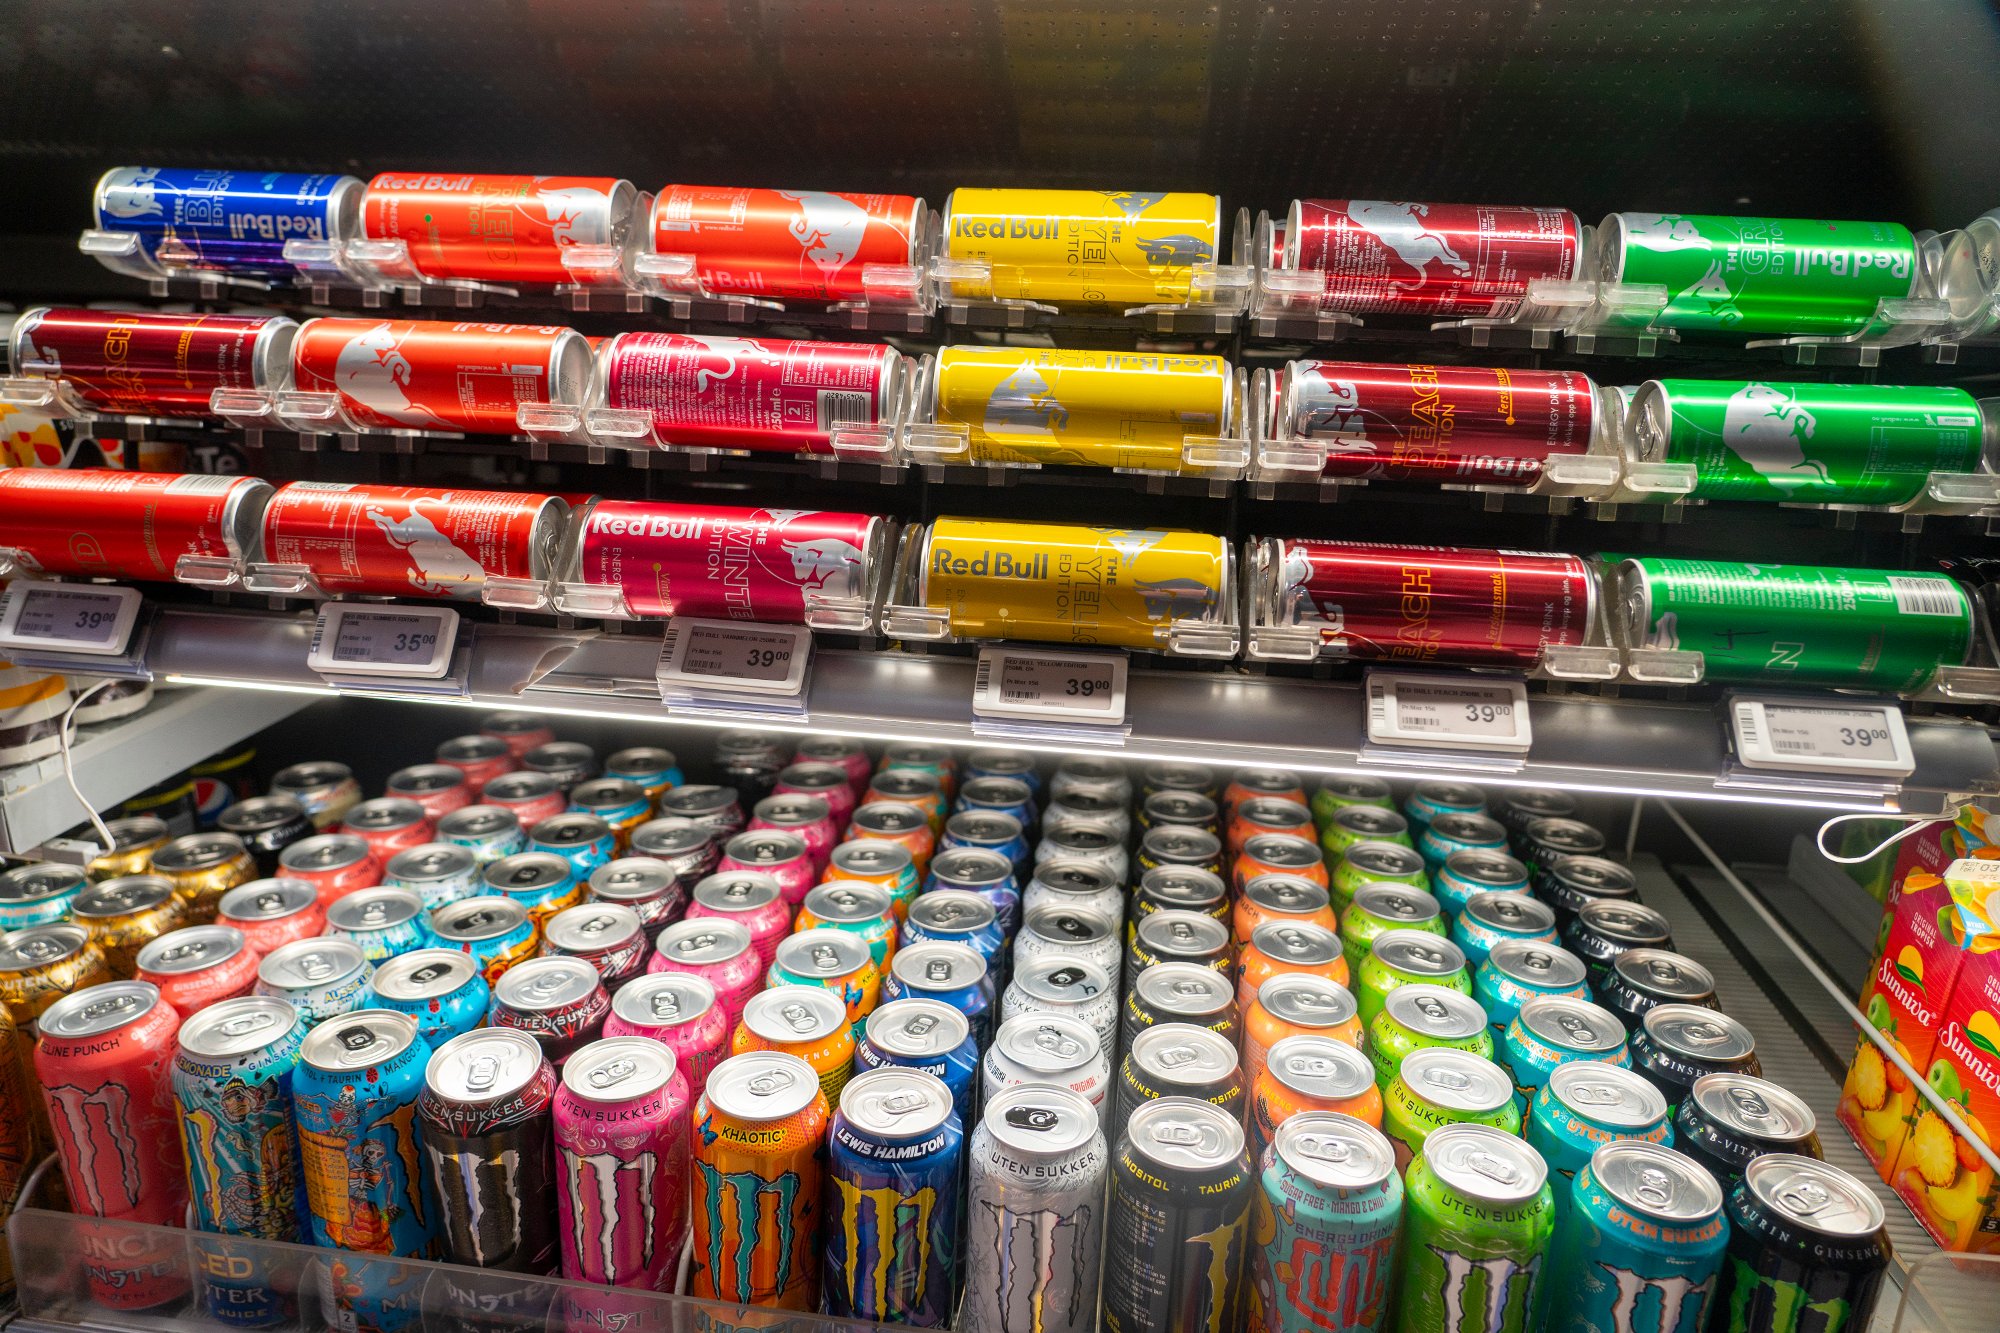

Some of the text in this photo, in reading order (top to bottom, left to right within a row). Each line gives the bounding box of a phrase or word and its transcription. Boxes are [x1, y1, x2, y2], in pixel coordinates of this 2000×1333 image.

[374, 175, 474, 192] Red Bull
[174, 192, 184, 225] THE
[229, 213, 323, 241] Red Bull
[955, 215, 1059, 240] Red Bull
[1726, 243, 1740, 273] THE
[1771, 221, 1785, 275] EDITION
[1794, 248, 1912, 279] Red Bull
[716, 270, 765, 290] Bull
[219, 343, 228, 371] DRINK
[770, 394, 783, 430] 250ml
[788, 406, 800, 416] 2
[1404, 364, 1438, 469] PEACH
[1547, 380, 1558, 447] ENERGY DRINK
[1456, 454, 1519, 476] Bull
[592, 512, 705, 539] Red Bull
[756, 520, 771, 545] THE
[707, 518, 727, 580] EDITION
[612, 547, 622, 586] ENERGY
[933, 548, 1048, 580] Red Bull
[1107, 556, 1117, 586] THE
[1056, 553, 1072, 620] EDITION
[1485, 572, 1504, 641] Ferskensmak
[1540, 602, 1553, 631] DRINK
[1433, 689, 1459, 697] PEACH
[1916, 844, 1940, 867] TROPISK
[1919, 836, 1941, 860] ORIGINAL
[1910, 920, 1935, 949] TROPISK
[1913, 912, 1937, 938] ORIGINAL
[172, 978, 214, 993] GINSENG
[512, 993, 603, 1030] UTEN SUKKER
[72, 1038, 120, 1058] PUNCH
[248, 1039, 302, 1072] GINSENG
[384, 1045, 416, 1077] MANGO
[858, 1040, 880, 1068] LEWIS
[175, 1055, 232, 1078] LEMONADE
[327, 1071, 362, 1085] TAURIN
[423, 1095, 525, 1123] UTEN SUKKER
[561, 1096, 662, 1122] UTEN SUKKER
[836, 1127, 946, 1161] LEWIS HAMILTON
[1566, 1118, 1612, 1143] UTEN
[990, 1151, 1096, 1178] UTEN SUKKER
[1121, 1154, 1241, 1195] INOSITOL TAURIN
[1279, 1179, 1303, 1204] SUGAR
[1303, 1192, 1325, 1211] FREE
[1330, 1199, 1361, 1215] MANGO
[1368, 1196, 1386, 1212] CHILI
[1439, 1193, 1550, 1223] UTEN SUKKER
[1294, 1222, 1357, 1244] ENERGY
[1606, 1208, 1724, 1244] UTEN SUKKER
[1735, 1195, 1880, 1262] TAURIN GINSENG
[1985, 1220, 1998, 1231] 5
